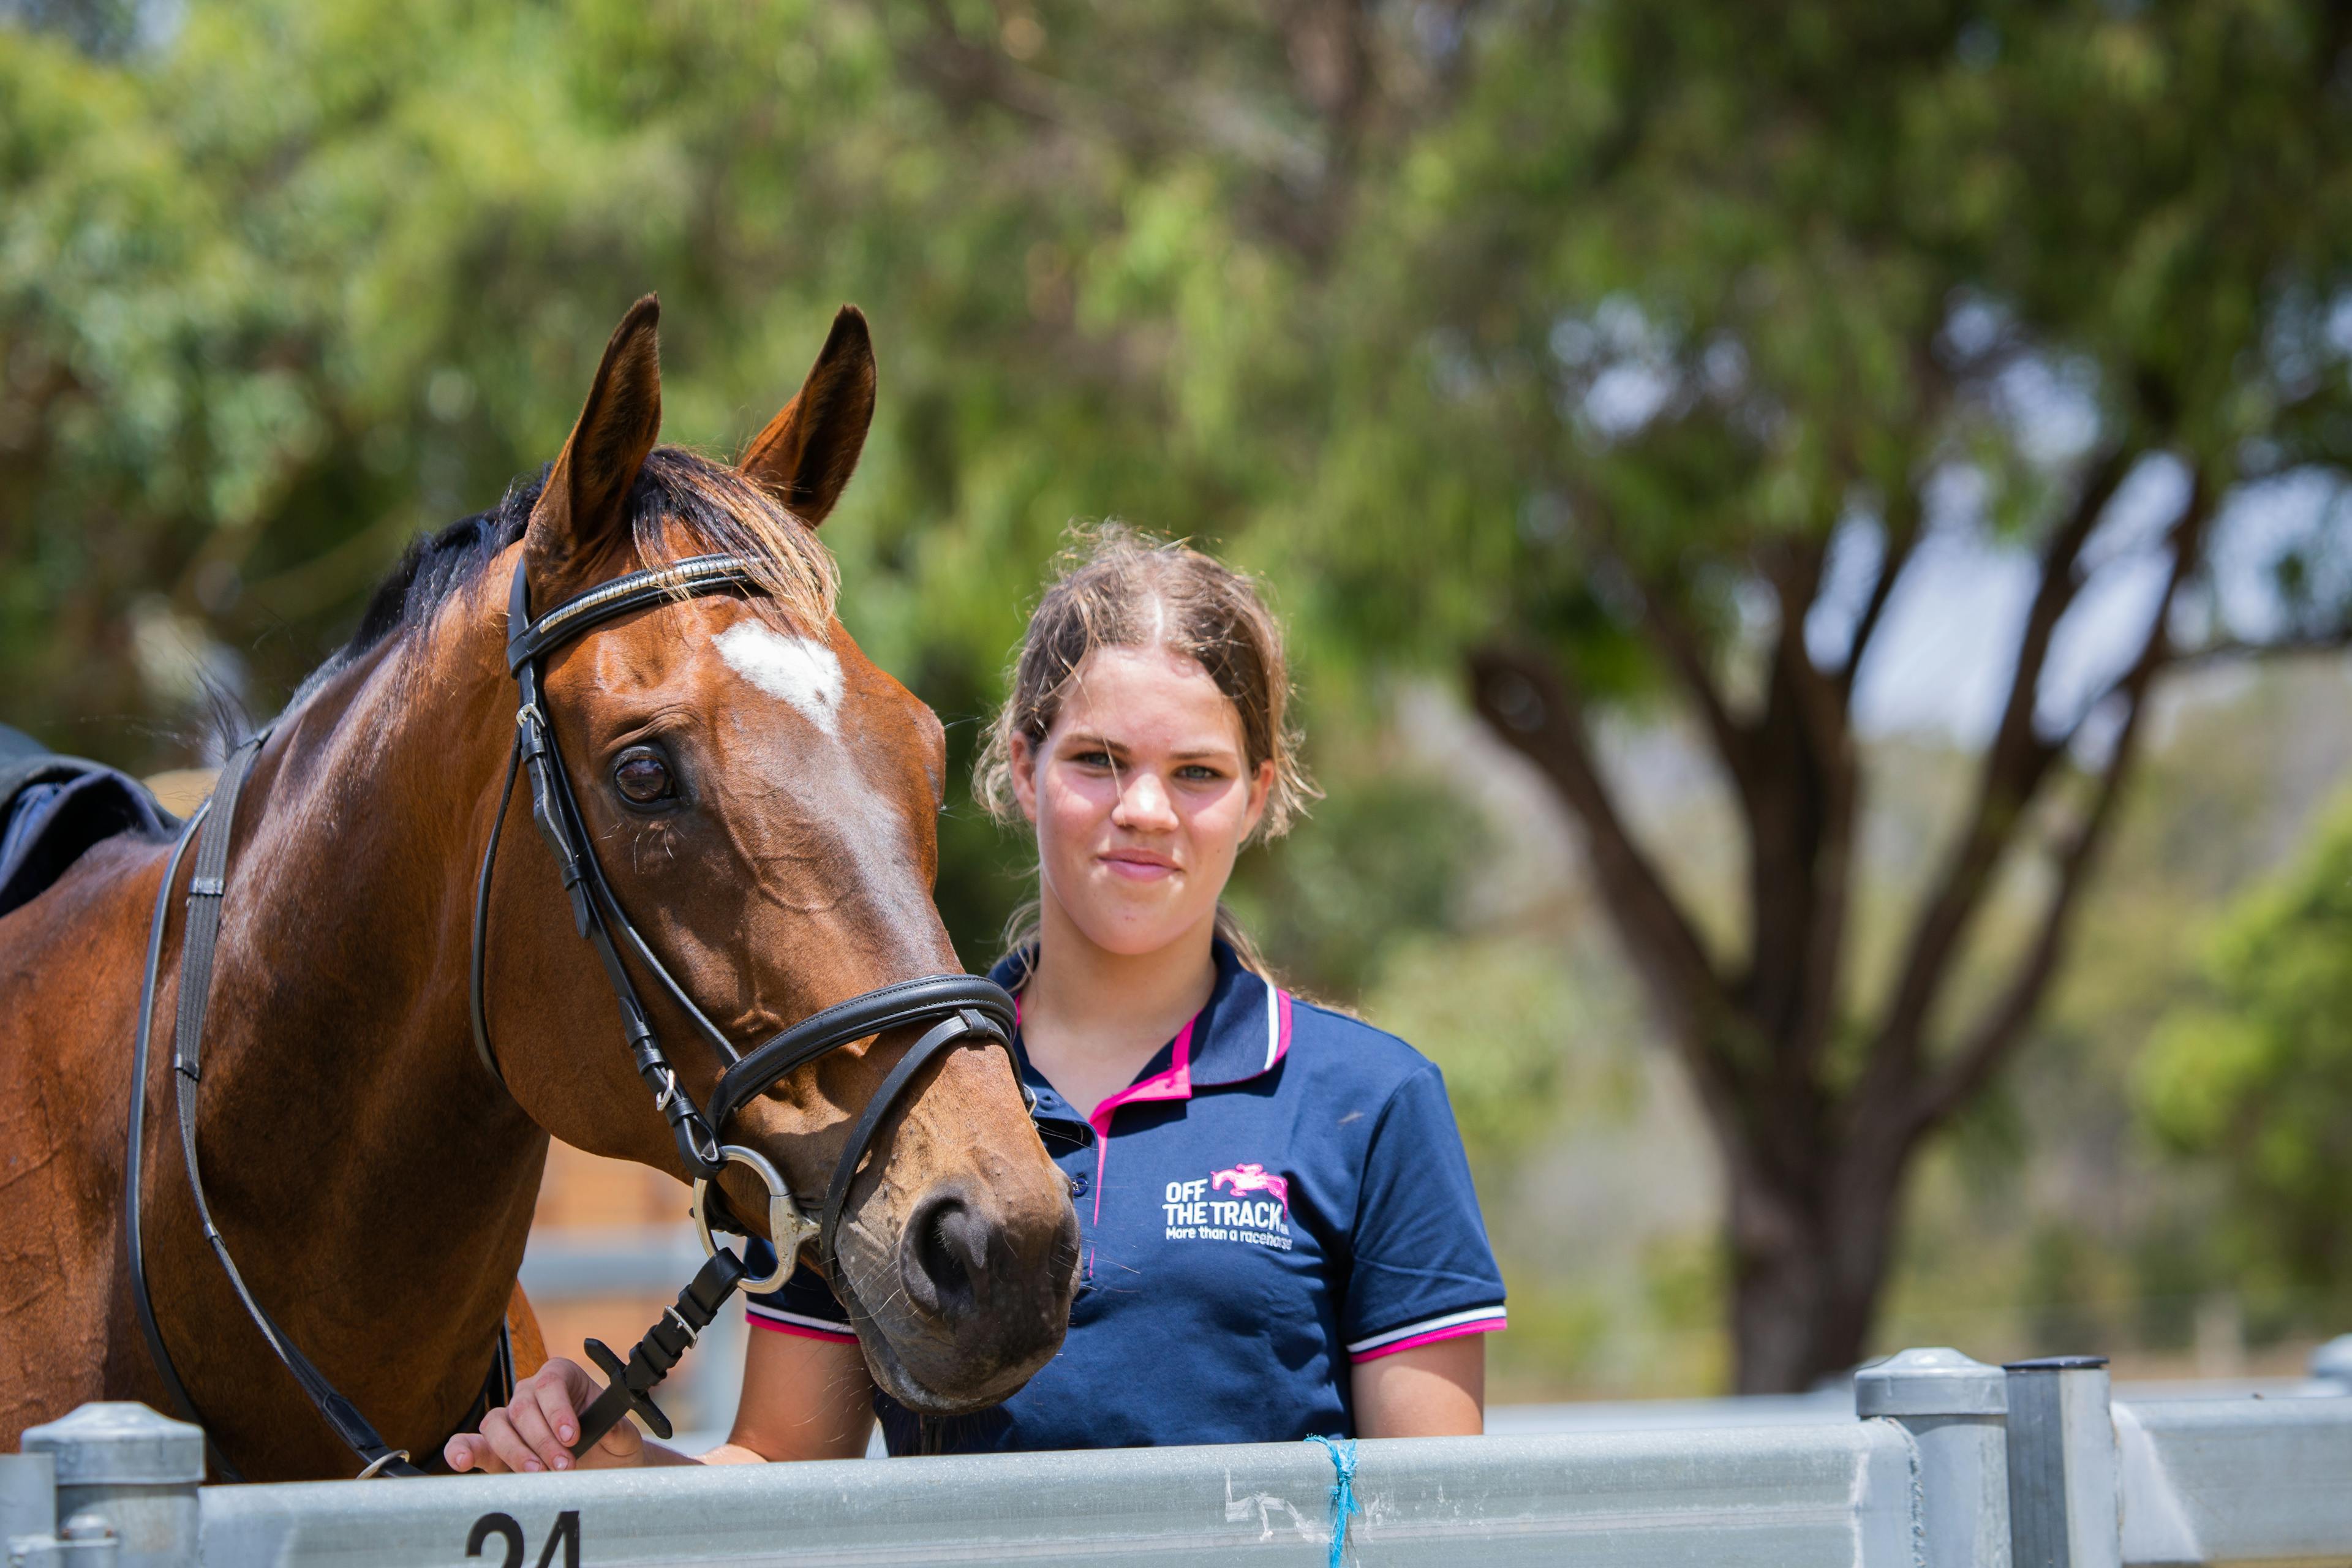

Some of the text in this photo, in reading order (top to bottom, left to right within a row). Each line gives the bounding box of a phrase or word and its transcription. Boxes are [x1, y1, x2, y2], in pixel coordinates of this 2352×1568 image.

[1166, 1178, 1208, 1203] OFF
[1162, 1202, 1208, 1226] THE
[1209, 1200, 1283, 1231] TRACK
[1166, 1225, 1292, 1250] More than a racehorse
[465, 1510, 580, 1568] 24
